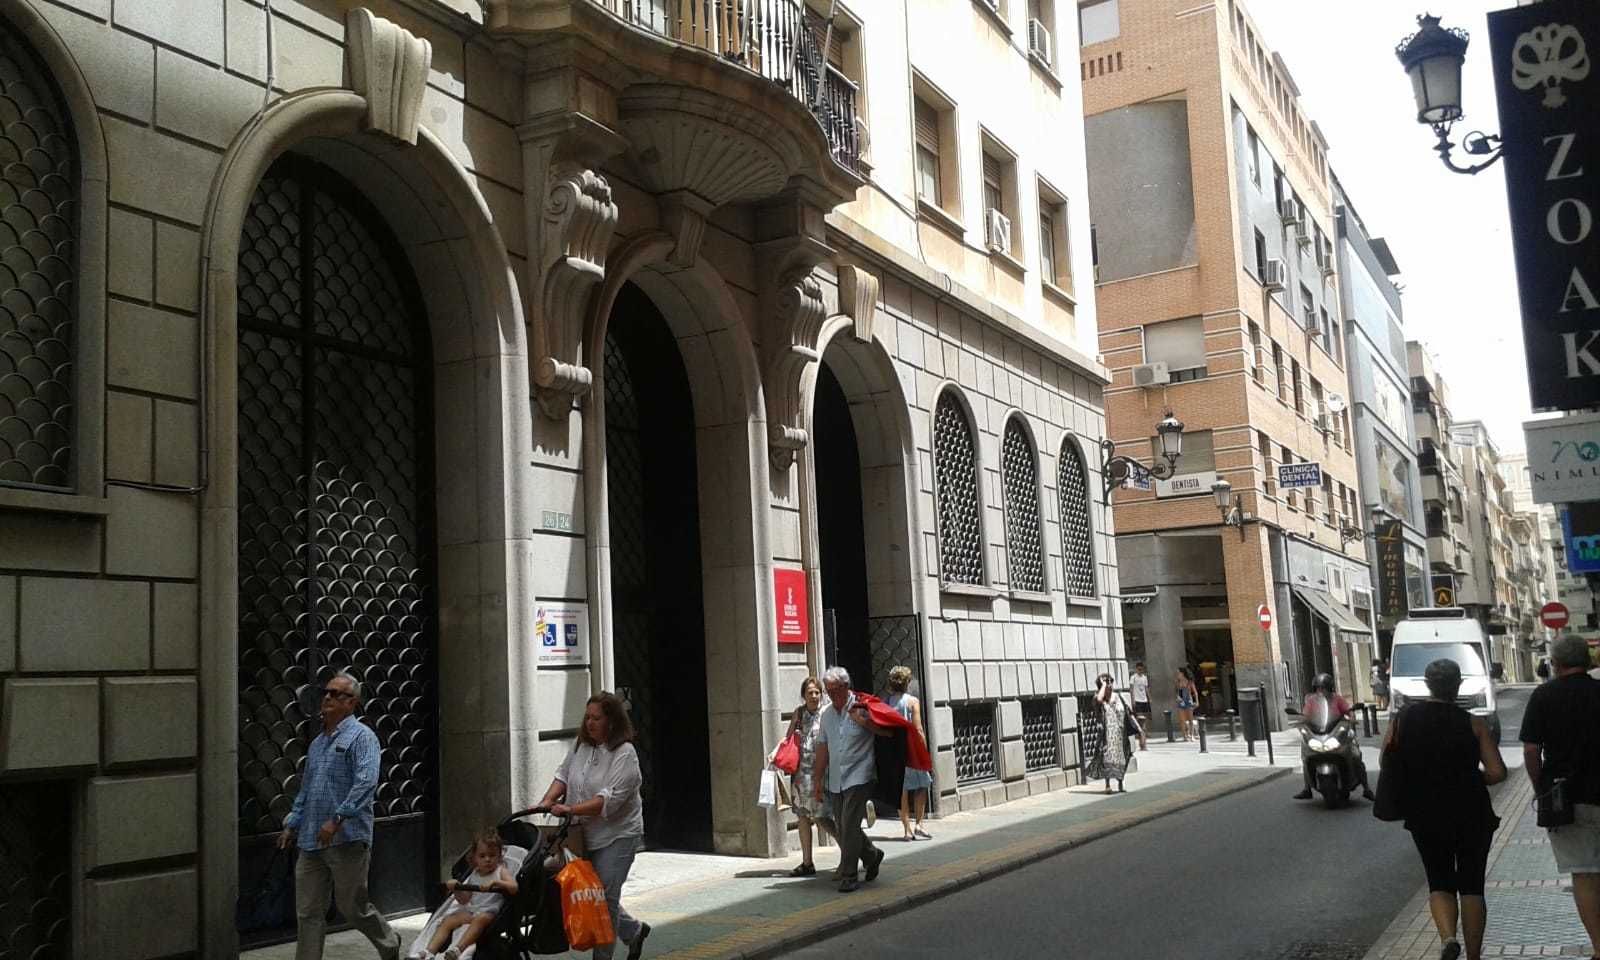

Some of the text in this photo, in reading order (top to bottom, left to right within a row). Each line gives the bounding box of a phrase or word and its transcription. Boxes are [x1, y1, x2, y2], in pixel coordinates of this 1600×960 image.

[1543, 133, 1600, 379] ZOAK
[1282, 472, 1319, 482] DENTAL
[1171, 479, 1200, 490] DENTISTA
